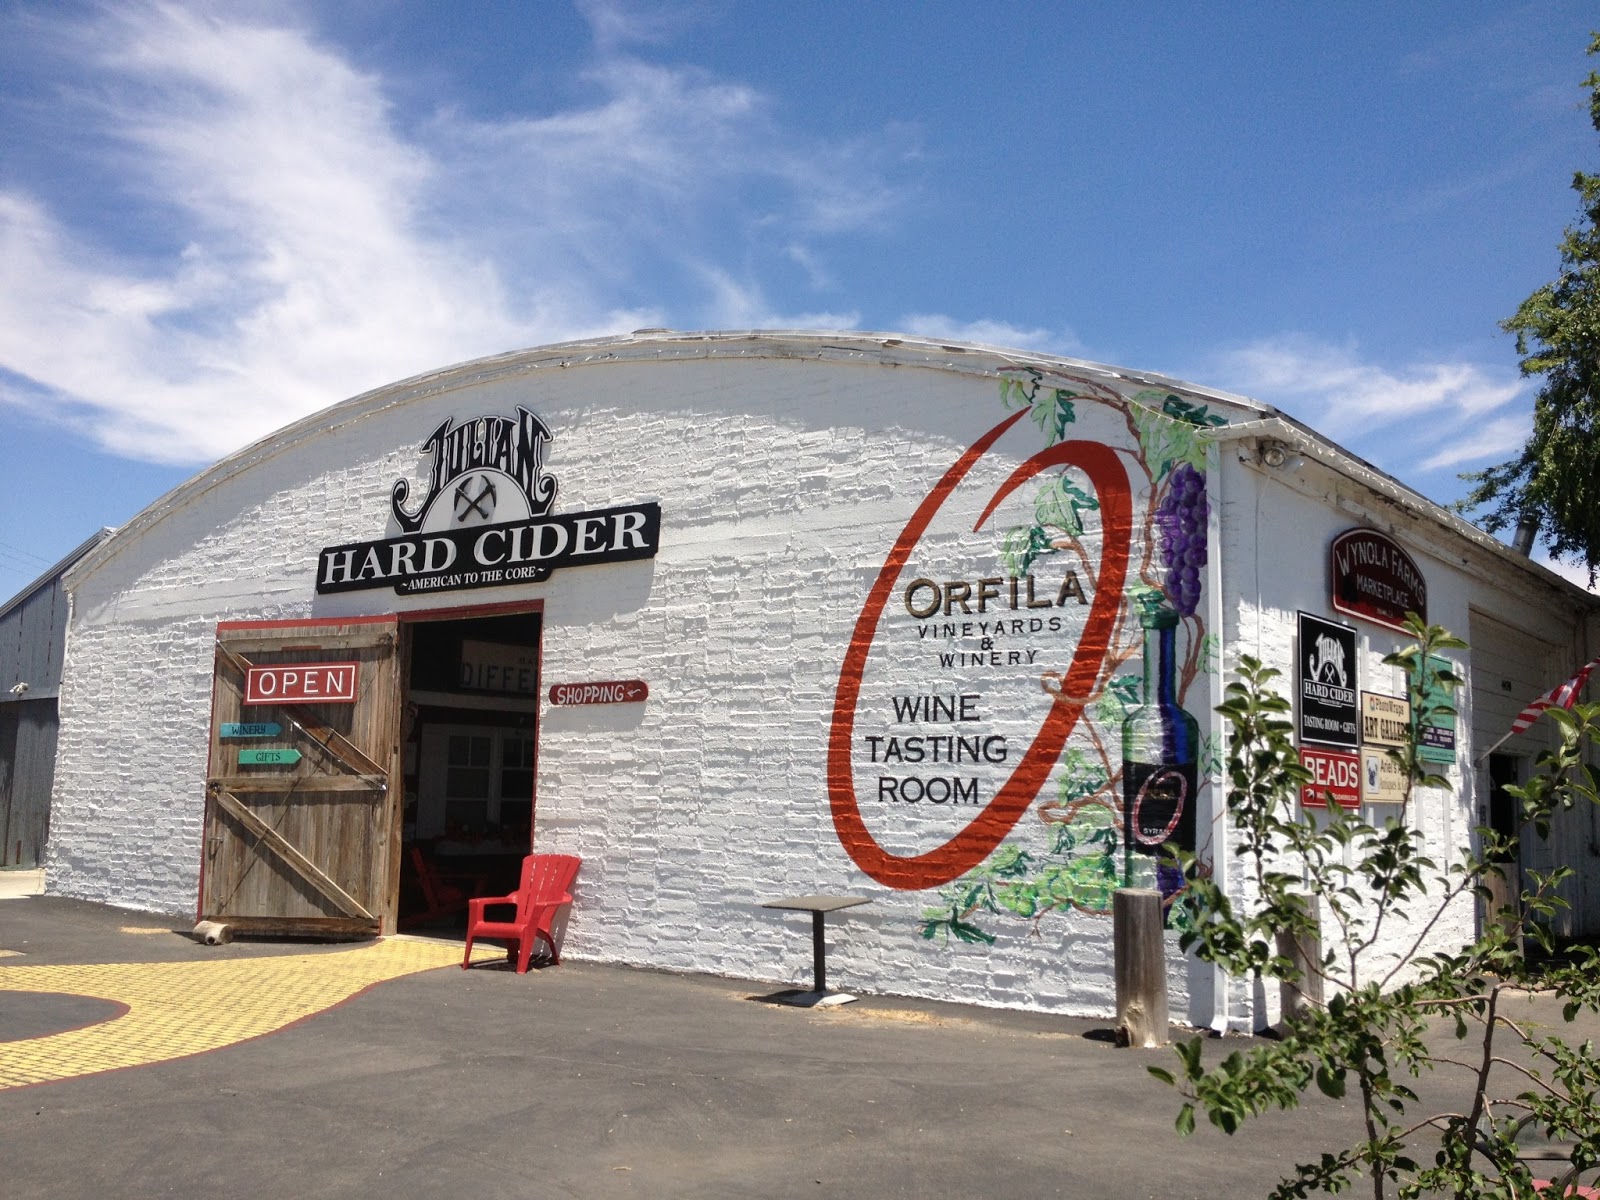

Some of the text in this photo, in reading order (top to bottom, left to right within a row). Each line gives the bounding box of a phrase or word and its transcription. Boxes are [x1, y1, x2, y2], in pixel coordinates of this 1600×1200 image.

[391, 404, 558, 535] JULIAN
[321, 511, 650, 585] HARD CIDER
[464, 572, 480, 584] TO
[481, 570, 504, 583] THE
[1336, 541, 1425, 606] WYNOLA FARMS
[904, 570, 1089, 619] ORFILA
[1356, 573, 1410, 609] MARKETPLACE
[918, 616, 1062, 639] VINEYARDS
[980, 637, 994, 651] &
[939, 650, 1037, 668] WINERY
[258, 670, 344, 695] OPEN
[462, 662, 540, 692] DIFFE
[556, 684, 625, 705] SHOPPING
[1304, 681, 1329, 698] HARD
[1329, 687, 1354, 703] CIDER
[892, 694, 981, 723] WINE
[231, 725, 266, 736] WINERY
[1303, 714, 1357, 734] TASTING ROOM GIFTS
[1364, 716, 1379, 738] ART
[1380, 717, 1411, 743] GALLER
[255, 752, 281, 762] GIFTS
[864, 735, 1008, 764] TASTING
[1303, 756, 1359, 789] BEADS
[878, 776, 979, 805] ROOM
